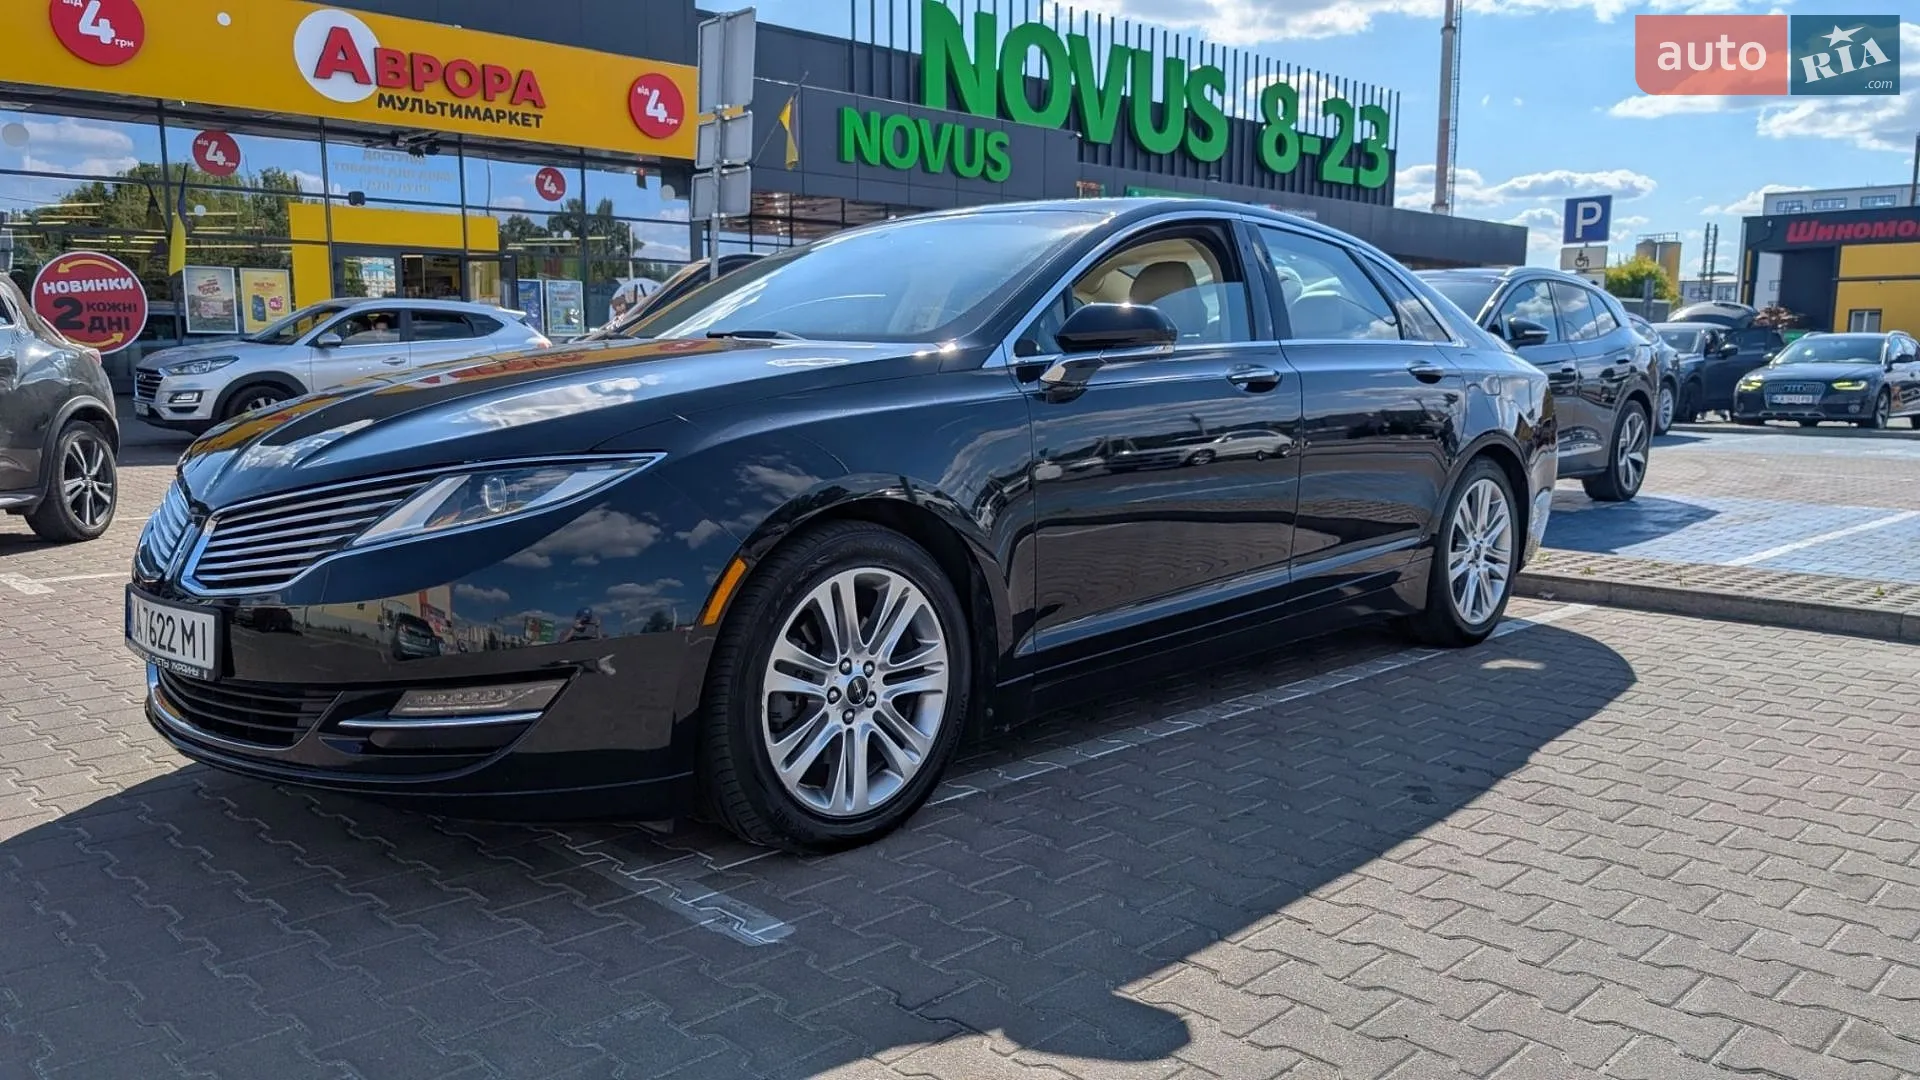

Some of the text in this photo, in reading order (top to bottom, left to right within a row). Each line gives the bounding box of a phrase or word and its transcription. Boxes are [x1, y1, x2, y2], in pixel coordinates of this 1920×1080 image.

[79, 0, 115, 44] 4
[115, 39, 134, 48] грн
[314, 26, 546, 109] АВРОРА
[377, 93, 543, 129] МУЛЬТИМАРКЕТ
[646, 89, 668, 123] 4
[921, 0, 1389, 190] NOVUS 8-23
[206, 141, 226, 166] 4
[838, 106, 1011, 183] NOVUS
[543, 175, 557, 194] 4
[1576, 201, 1603, 238] P
[1786, 219, 1920, 243] Шиномо
[42, 277, 133, 295] НОВИНКИ
[53, 296, 137, 330] 2 КОЖНІ
[88, 315, 130, 333] ДНІ
